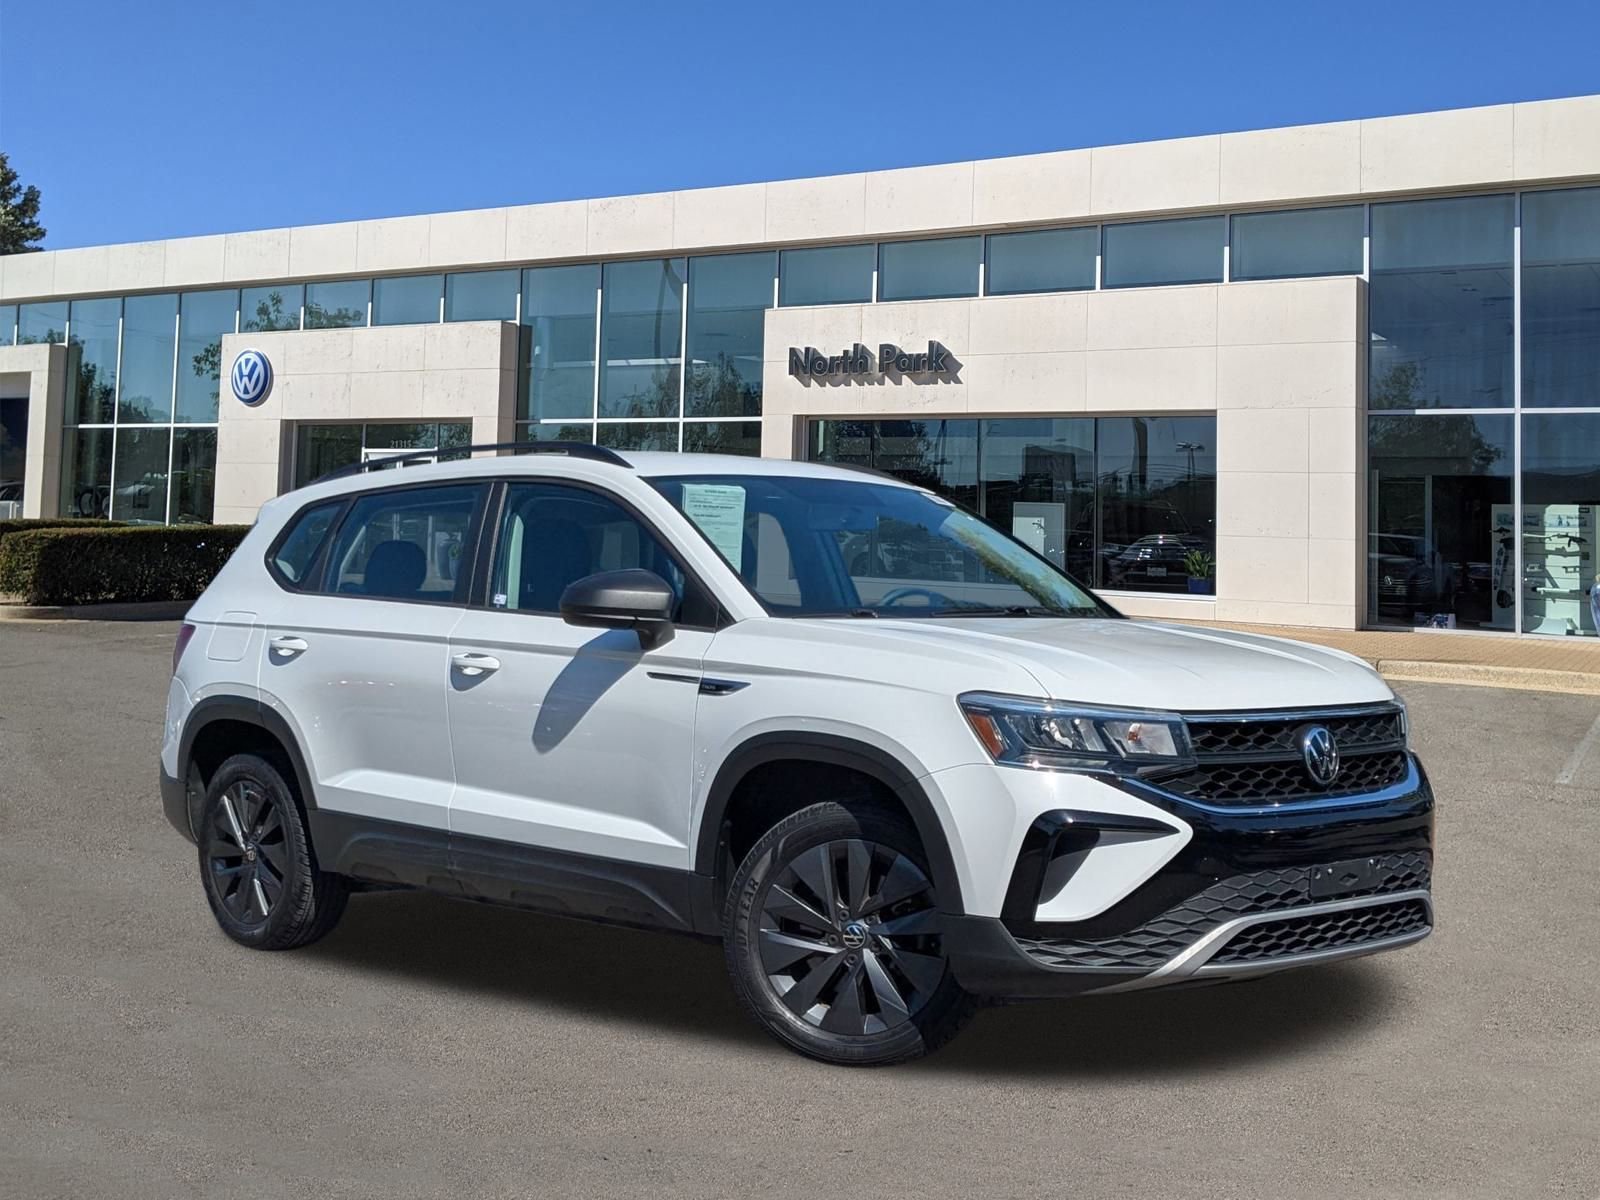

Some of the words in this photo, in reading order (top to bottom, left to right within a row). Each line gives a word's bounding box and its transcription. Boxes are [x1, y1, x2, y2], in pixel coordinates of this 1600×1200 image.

[231, 350, 268, 403] VW
[788, 343, 871, 376] North
[878, 340, 949, 373] Park
[1304, 727, 1339, 784] VW
